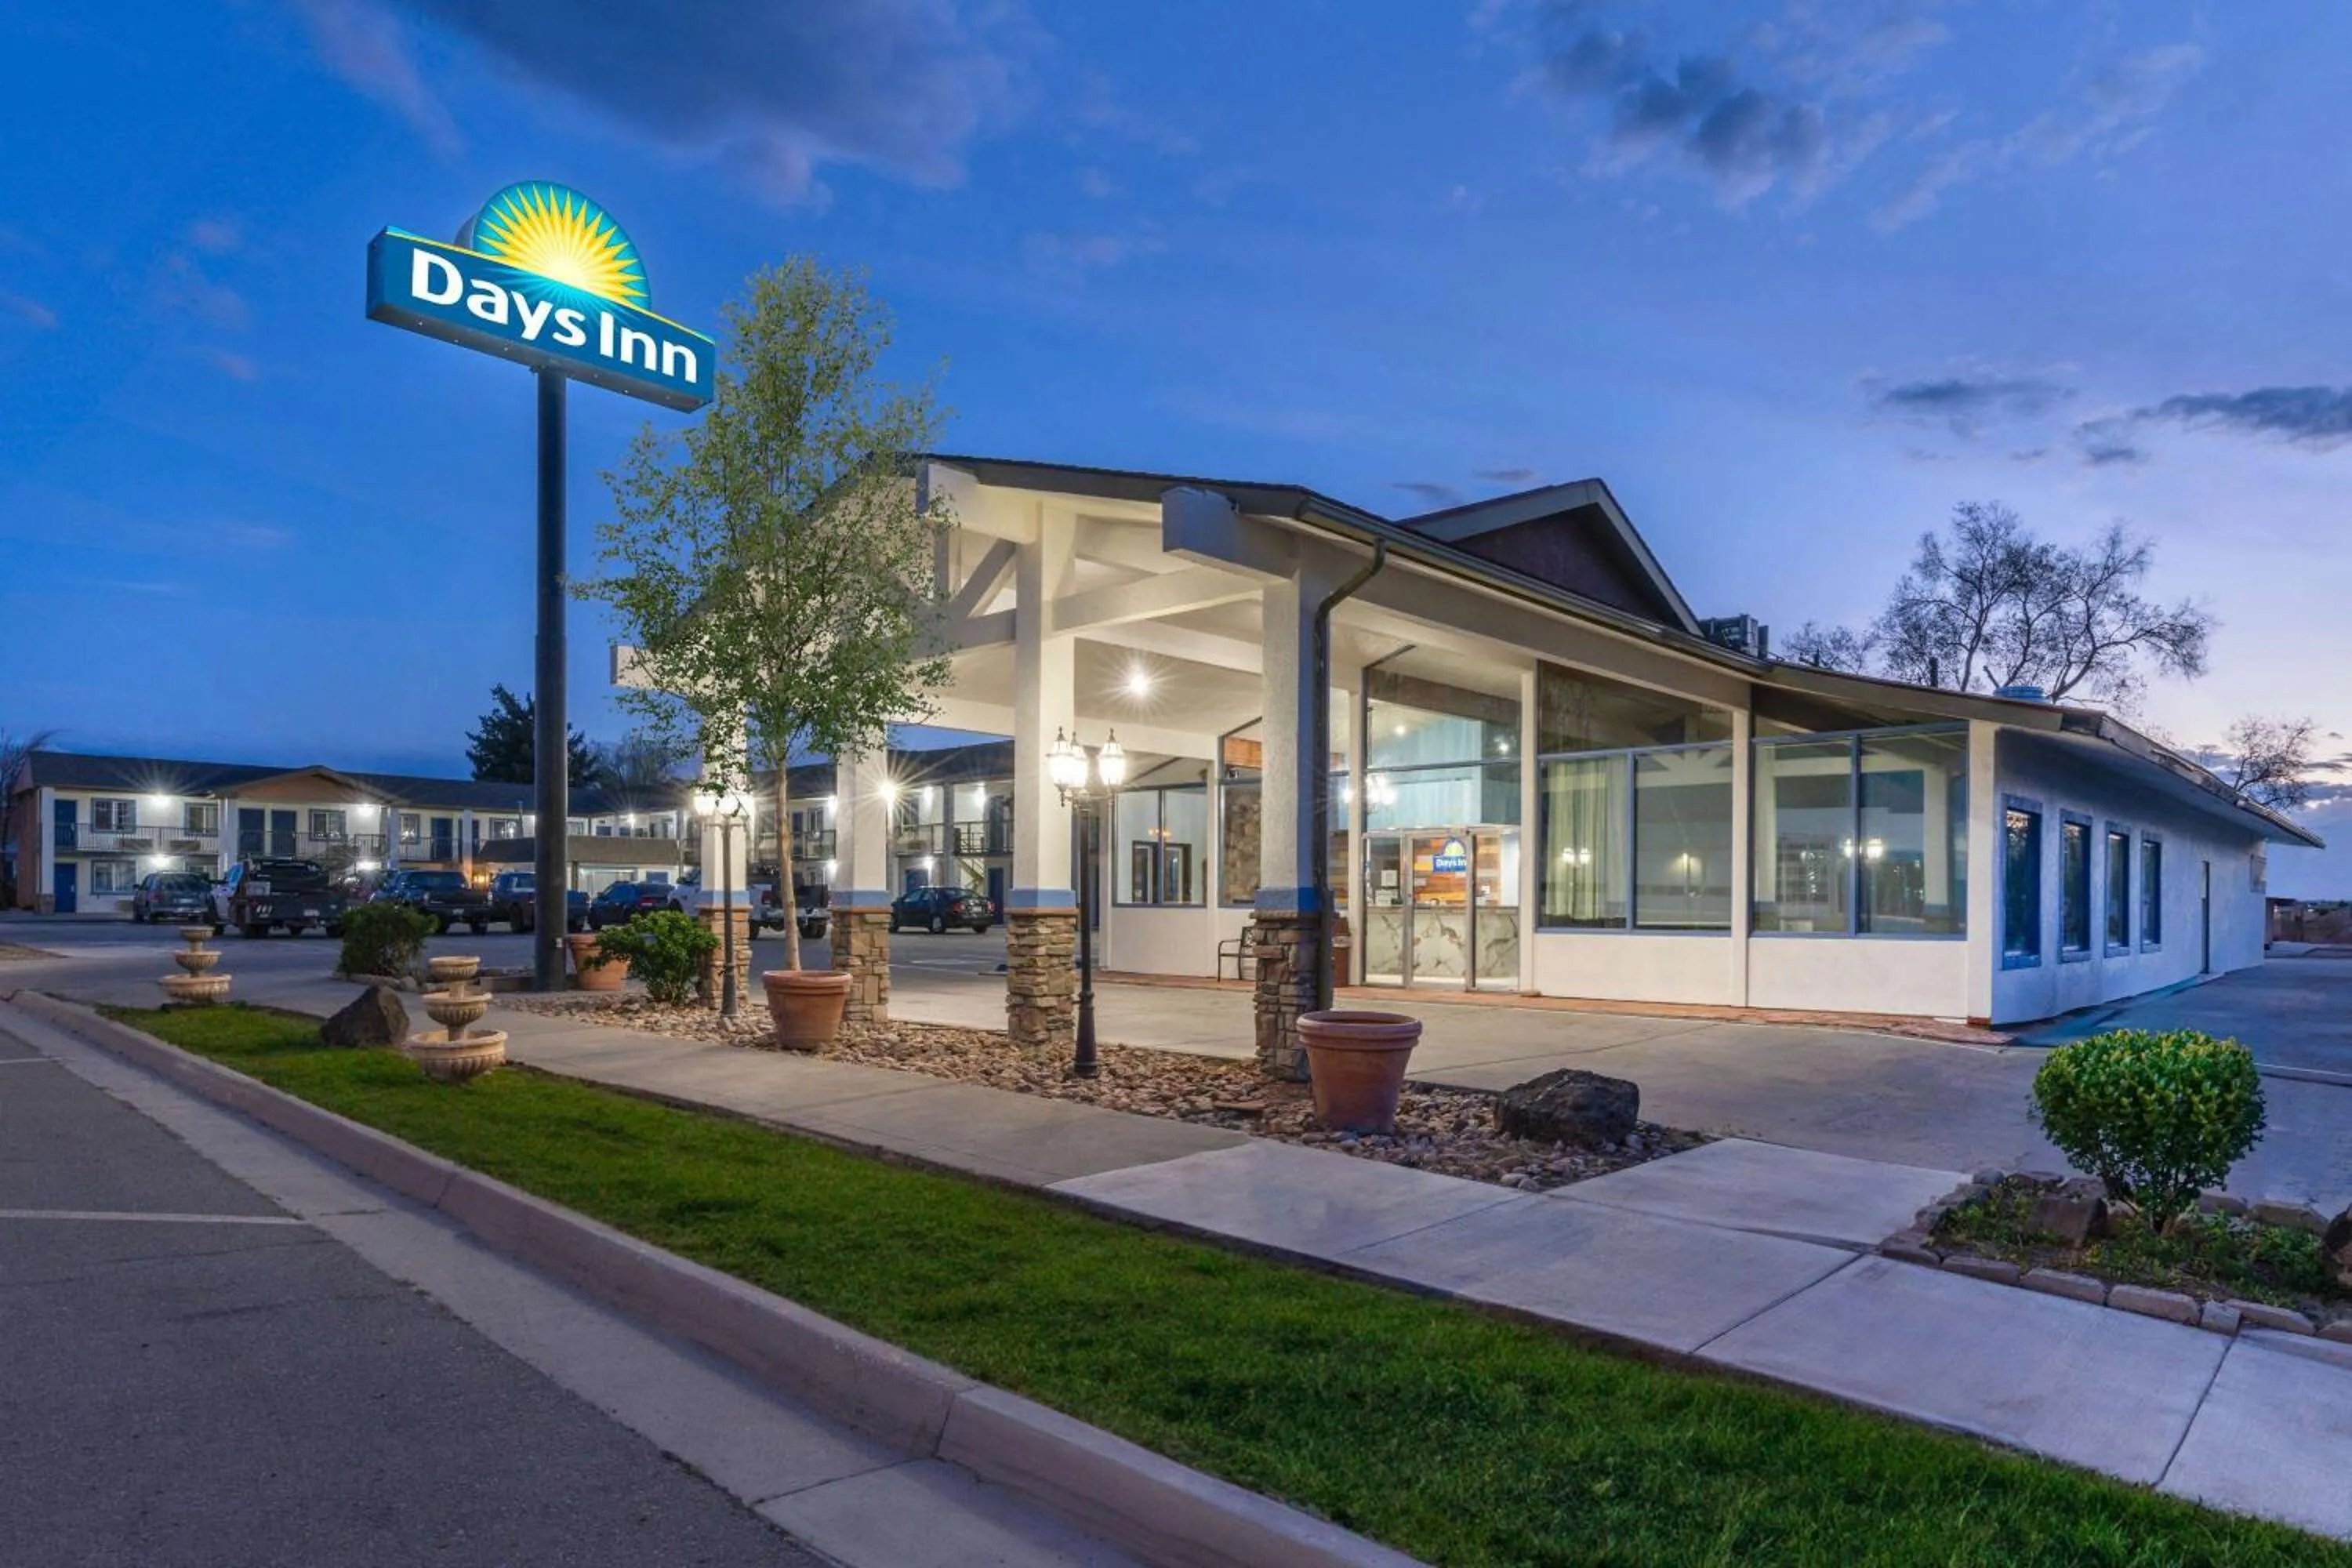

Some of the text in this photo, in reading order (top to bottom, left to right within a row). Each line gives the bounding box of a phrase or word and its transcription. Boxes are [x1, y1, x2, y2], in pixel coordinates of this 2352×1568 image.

[412, 247, 697, 383] Days Inn
[1436, 858, 1457, 869] Days
